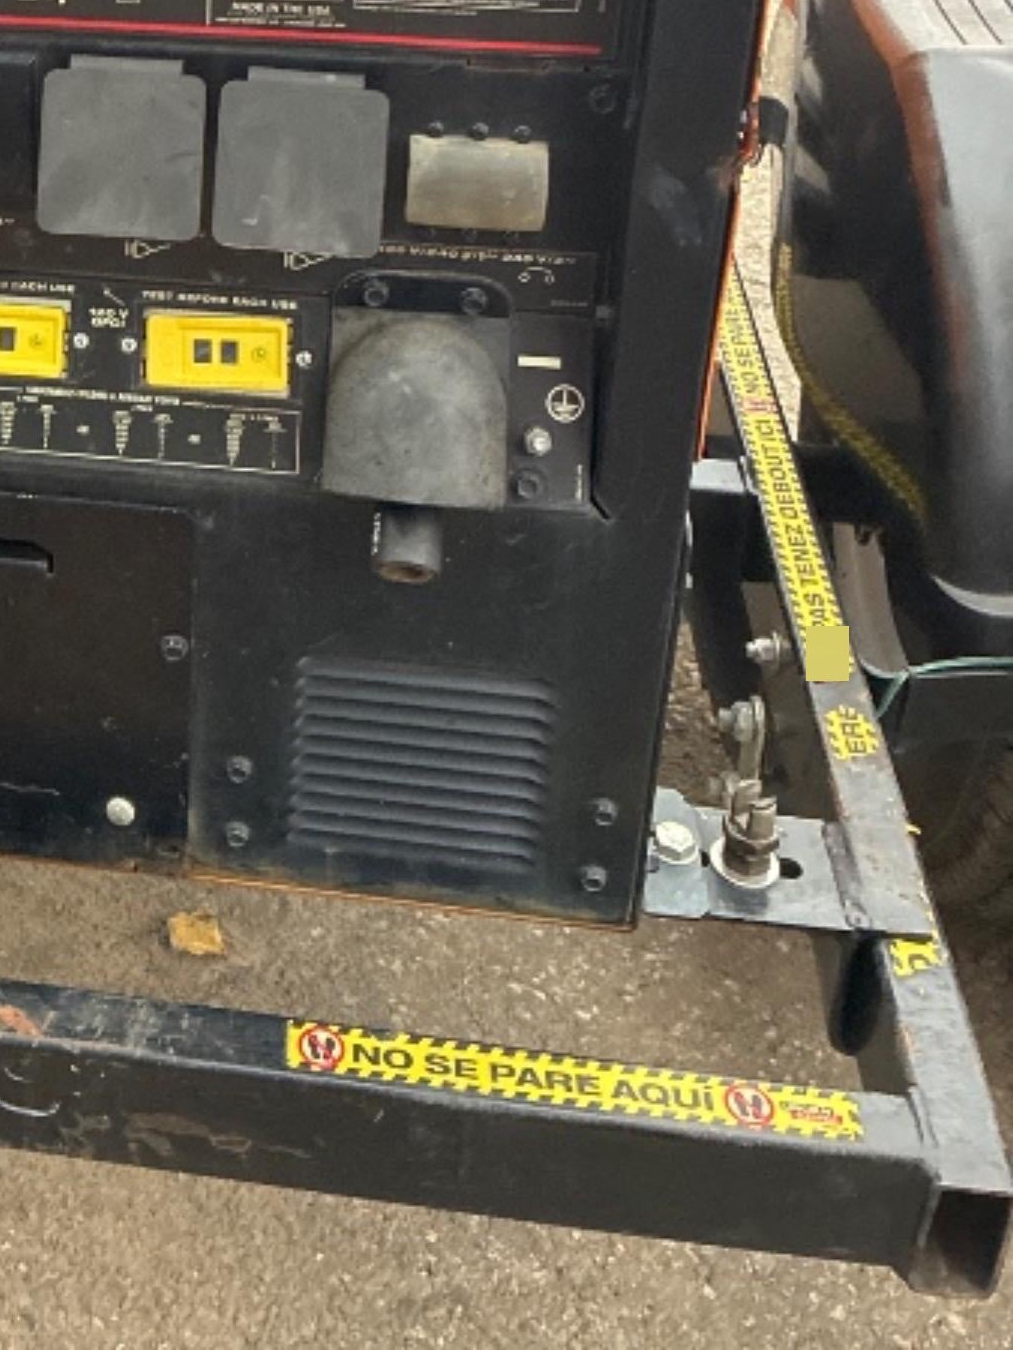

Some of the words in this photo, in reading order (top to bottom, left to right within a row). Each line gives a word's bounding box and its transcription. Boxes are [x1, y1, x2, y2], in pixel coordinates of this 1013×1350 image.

[755, 418, 778, 442] ICI
[762, 444, 799, 520] DEBOUT
[784, 522, 820, 586] TENEZ
[351, 1041, 414, 1070] NO
[423, 1054, 479, 1080] SE
[490, 1063, 602, 1098] PARE
